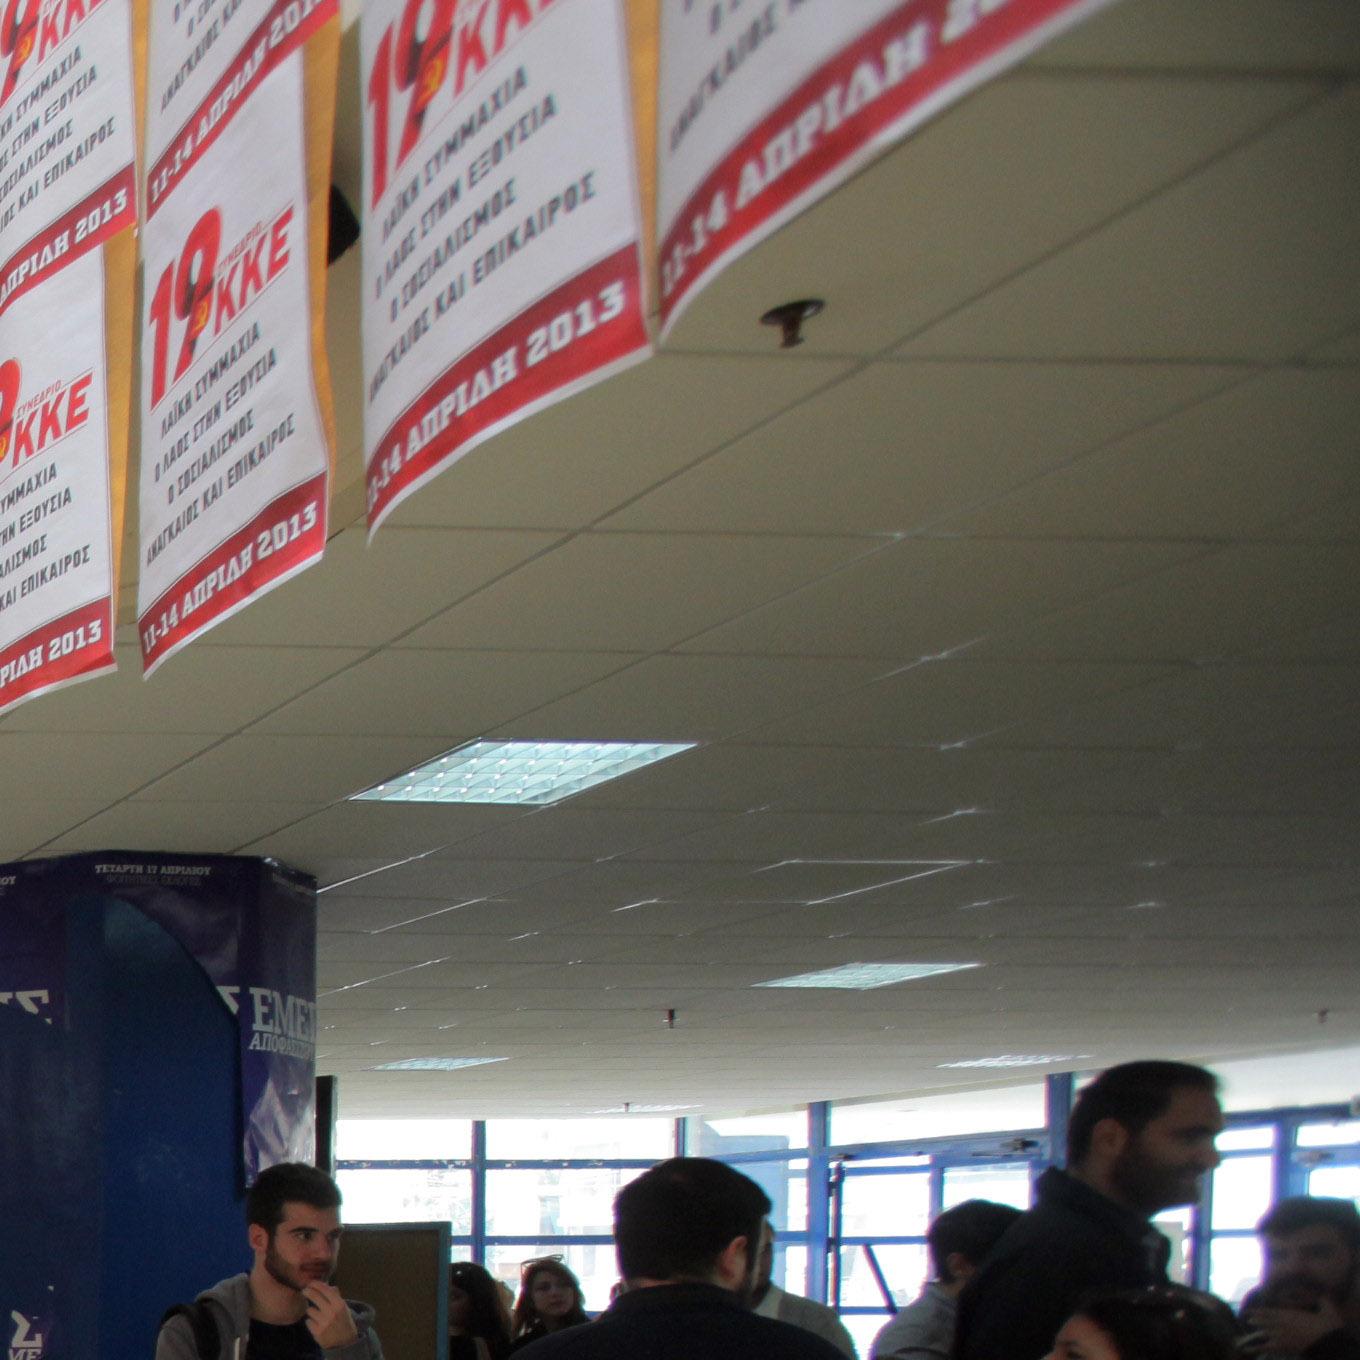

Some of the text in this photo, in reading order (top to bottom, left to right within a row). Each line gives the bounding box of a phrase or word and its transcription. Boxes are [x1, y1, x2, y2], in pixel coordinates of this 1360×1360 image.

[43, 116, 115, 190] ΕΠΙΚΑΙΡΟΣ
[734, 20, 932, 211] ΑΠΡΙΛΗ
[0, 187, 128, 308] ΑΠΡΙΛΗ 2013
[214, 205, 294, 337] ΚΚΕ
[472, 170, 597, 286] ΕΠΙΚΑΙΡΟΣ
[149, 205, 222, 411] 19
[195, 321, 260, 402] ΣΥΜΜΑΧΙΑ
[405, 280, 627, 461] ΑΠΡΙΛΗ 2013
[12, 372, 93, 468] ΚΚΕ
[203, 477, 224, 512] ΚΑΙ
[227, 412, 296, 488] ΕΠΙΚΑΙΡΟΣ
[19, 486, 72, 533] ΕΞΟΥΣΙΑ
[21, 544, 91, 598] ΕΠΙΚΑΙΡΟΣ
[143, 501, 318, 654] 11-14 ΑΠΡΙΛΗ 2013
[48, 619, 102, 662] 2013
[95, 864, 211, 876] ΤΕΤΑΡΤΗ 17 ΑΠΡΙΛΙΟΥ
